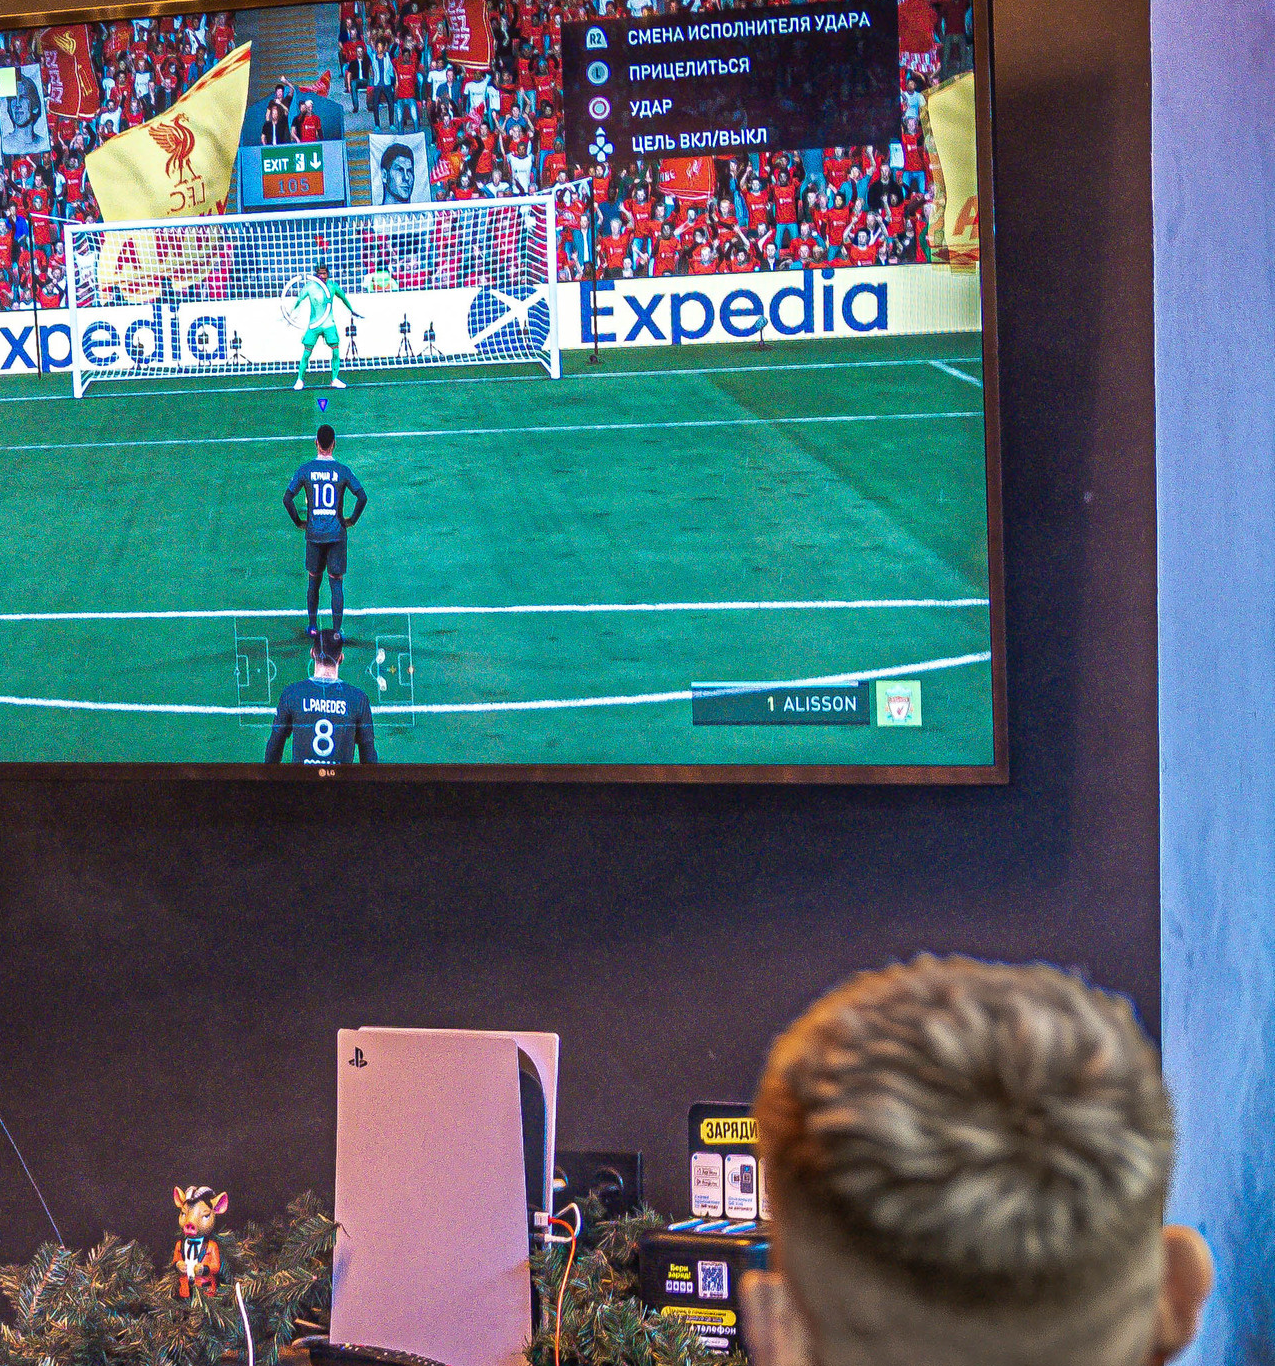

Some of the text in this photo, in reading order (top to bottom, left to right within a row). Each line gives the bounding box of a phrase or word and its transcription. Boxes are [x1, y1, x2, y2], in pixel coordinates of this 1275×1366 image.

[590, 33, 602, 45] R2
[628, 12, 871, 45] СМЕНА ИСПОЛНИТЕЛЯ УДАРА
[629, 56, 750, 81] ПРИЦЕЛИТЬСЯ
[629, 99, 673, 119] УДАР
[632, 128, 767, 154] ЦЕЛЬ ВКЛ/ВЫКЛ
[263, 157, 289, 174] EXIT
[278, 177, 310, 194] 105
[580, 269, 888, 346] Expedia
[313, 483, 335, 508] 10
[303, 698, 347, 715] L.PAREDES
[767, 696, 857, 712] 1 ALISSON
[312, 718, 334, 757] 8
